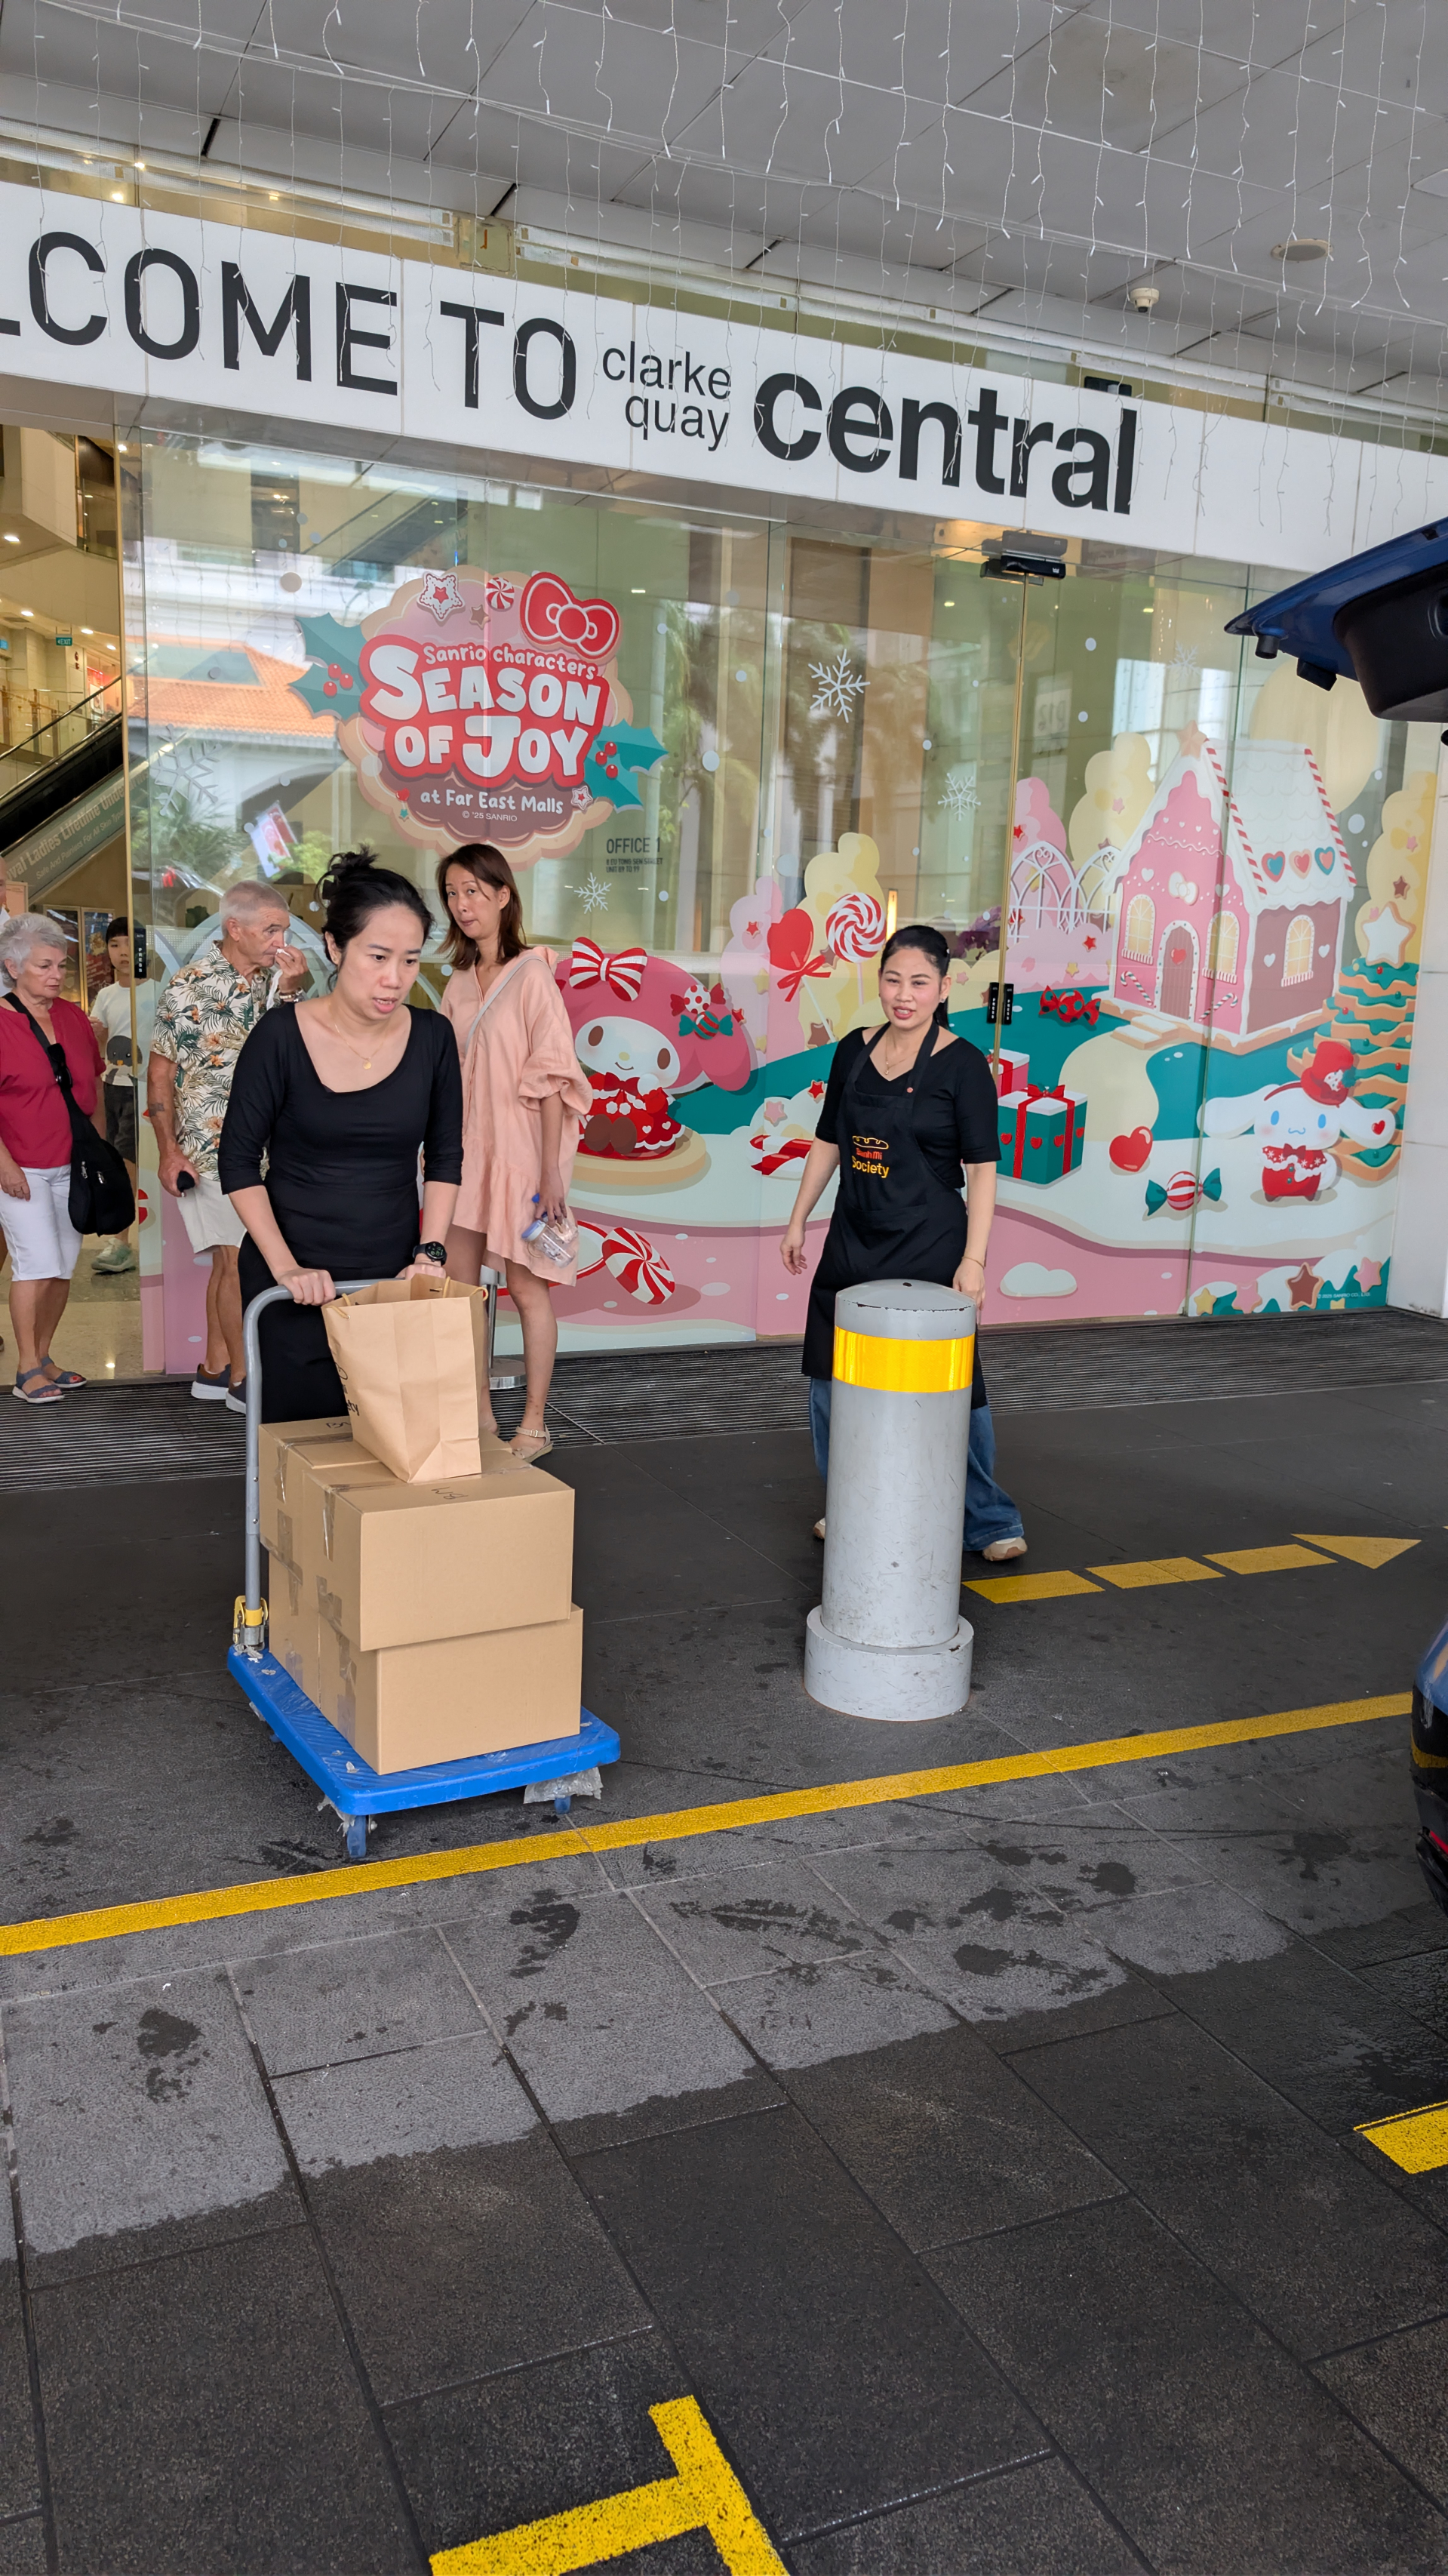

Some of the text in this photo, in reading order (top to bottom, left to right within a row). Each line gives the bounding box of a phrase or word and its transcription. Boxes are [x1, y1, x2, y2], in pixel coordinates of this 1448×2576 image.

[0, 230, 577, 420] COME TO
[602, 340, 732, 402] clarke
[625, 390, 730, 451] quay
[754, 372, 1138, 515] central
[369, 645, 601, 726] SEASON
[423, 645, 596, 680] Sanrio characters
[394, 716, 589, 777] OF JOY
[420, 789, 564, 814] at Far East Malls
[485, 813, 518, 822] SANRIO
[26, 834, 61, 866] Ladies
[60, 805, 101, 841] Lifetime
[36, 866, 50, 880] Safe
[50, 856, 61, 870] And
[61, 839, 84, 861] Painless
[82, 833, 93, 845] For
[606, 837, 661, 854] OFFICE 1
[644, 857, 663, 866] STREET
[852, 1155, 890, 1178] Society
